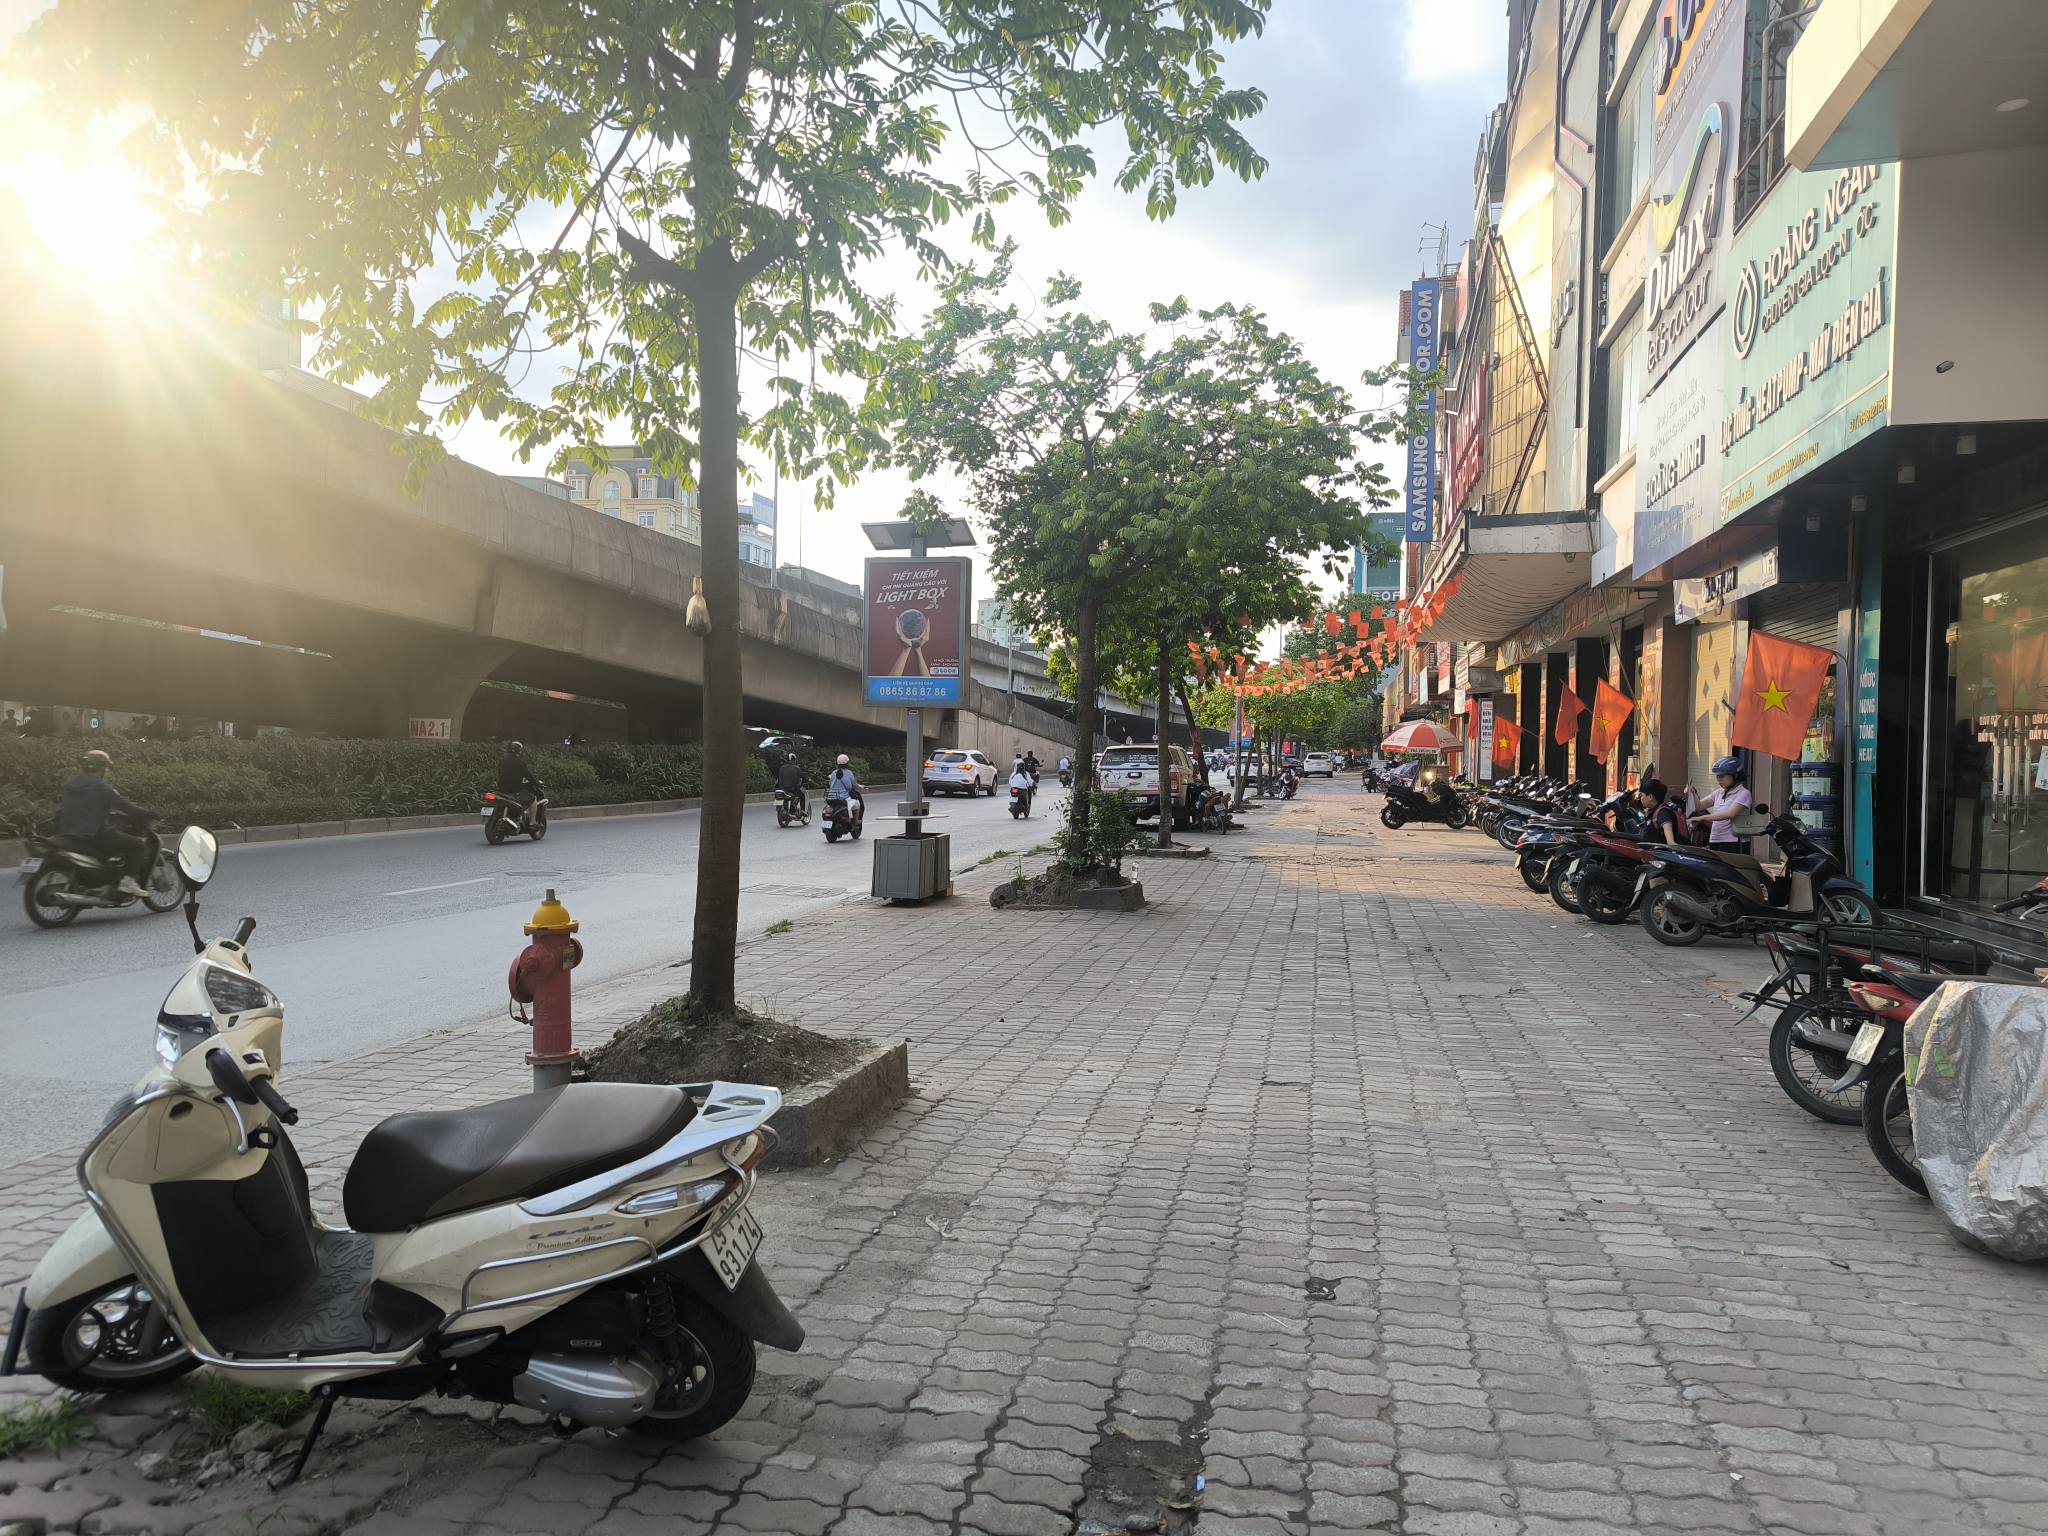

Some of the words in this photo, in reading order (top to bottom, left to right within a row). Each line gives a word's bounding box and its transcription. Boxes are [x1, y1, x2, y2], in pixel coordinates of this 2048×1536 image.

[1647, 209, 1712, 331] Dulux
[1669, 270, 1711, 344] colour
[1678, 435, 1705, 482] MINH
[876, 590, 917, 603] LIGHT
[917, 587, 949, 600] BOX
[719, 1217, 758, 1284] 931.74
